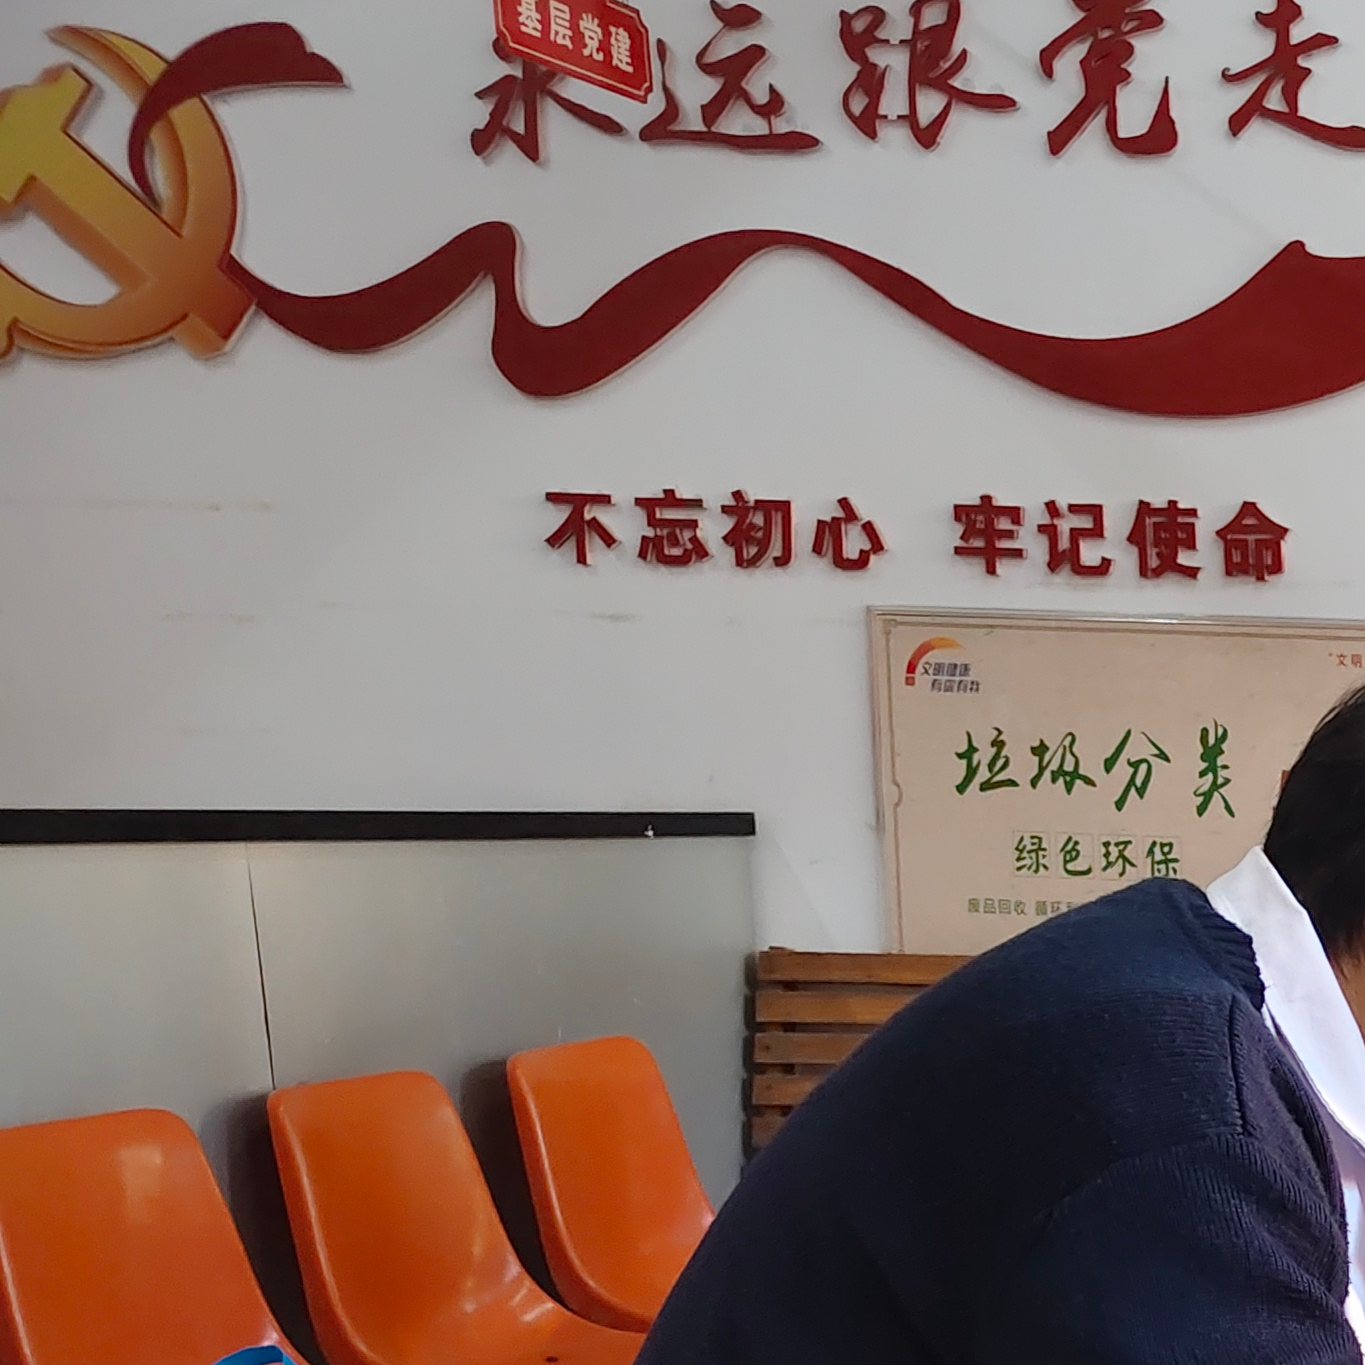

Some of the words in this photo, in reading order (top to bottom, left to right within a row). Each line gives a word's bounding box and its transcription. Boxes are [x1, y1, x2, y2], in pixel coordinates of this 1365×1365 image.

[516, 0, 634, 74] 基层党建
[544, 488, 885, 573] 不忘初心
[951, 493, 1290, 583] 牢记使命
[954, 717, 1236, 819] 垃圾分类
[1014, 834, 1181, 879] 绿色环保
[967, 897, 1028, 916] 废品回收
